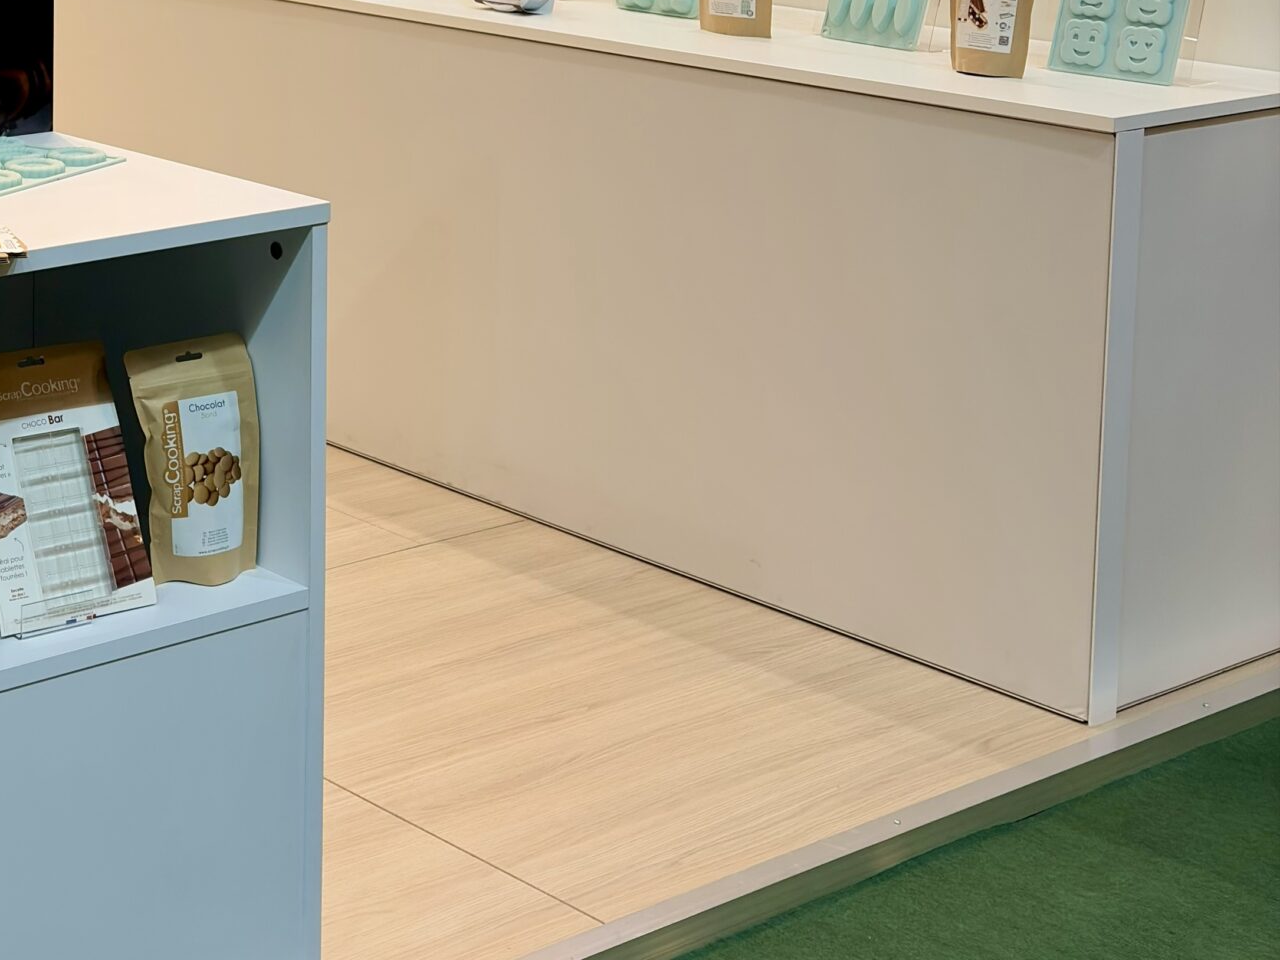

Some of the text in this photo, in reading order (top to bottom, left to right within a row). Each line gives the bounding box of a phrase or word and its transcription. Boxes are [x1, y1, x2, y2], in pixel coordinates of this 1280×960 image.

[188, 399, 226, 413] Chocolat
[21, 413, 64, 430] CHOCO Bar
[10, 556, 24, 566] pour
[0, 563, 25, 574] tablettes
